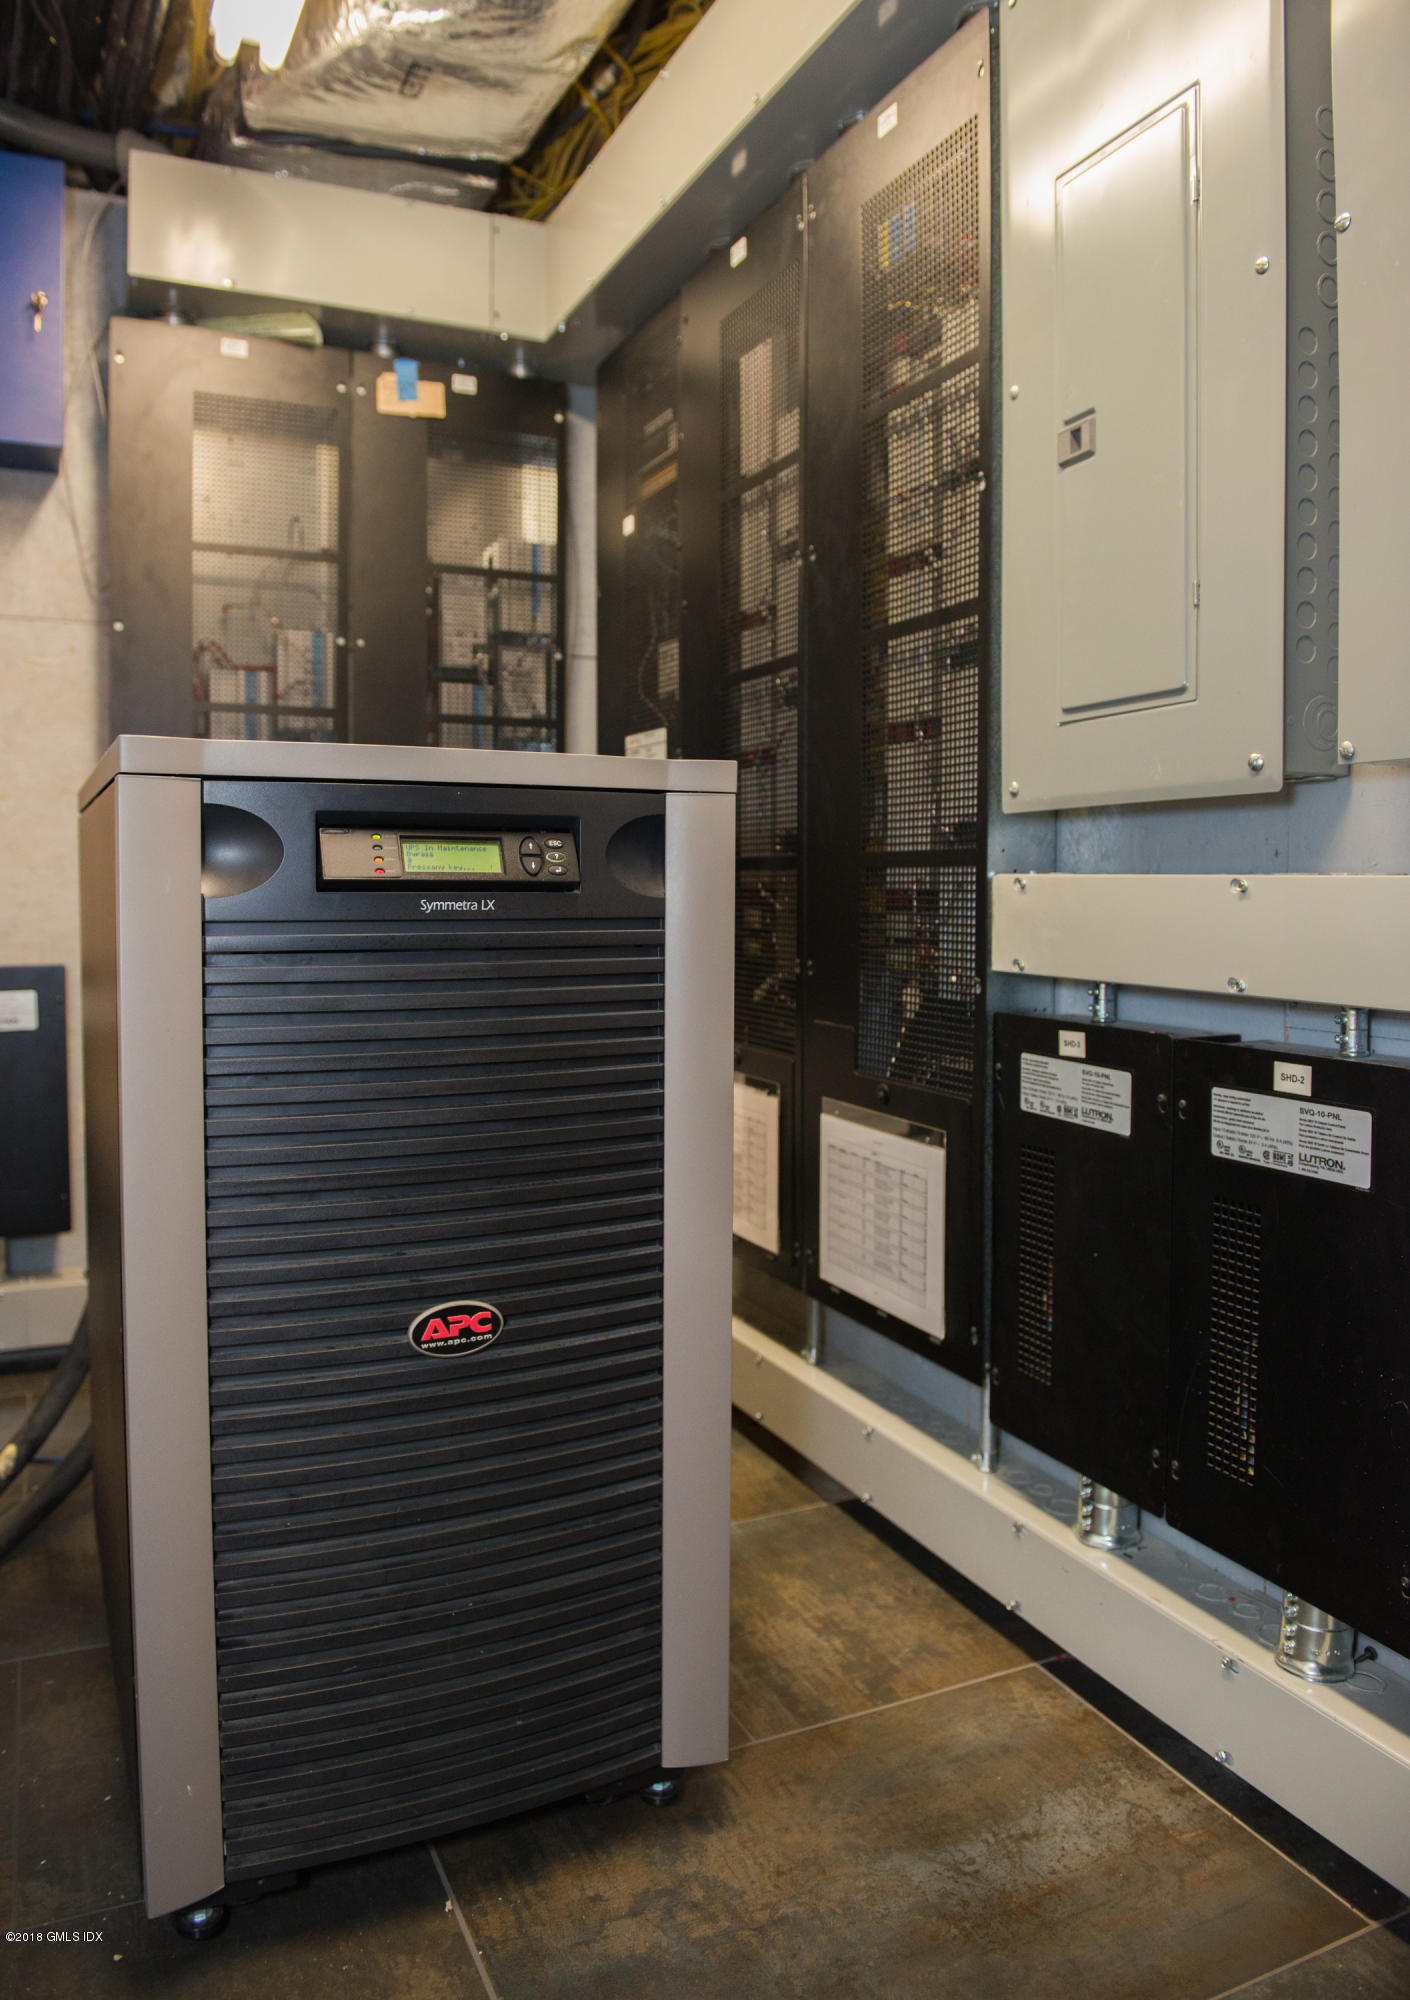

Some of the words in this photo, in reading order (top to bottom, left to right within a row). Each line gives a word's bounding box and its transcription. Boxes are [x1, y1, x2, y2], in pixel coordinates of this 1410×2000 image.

[420, 899, 478, 914] Symmetra
[481, 899, 496, 911] LX
[1280, 1072, 1305, 1085] SHD-2
[1299, 1107, 1342, 1121] SVQ-10-PNL
[1298, 1152, 1345, 1170] LUTRON
[420, 1311, 493, 1342] APC
[420, 1333, 493, 1349] www.apc.com
